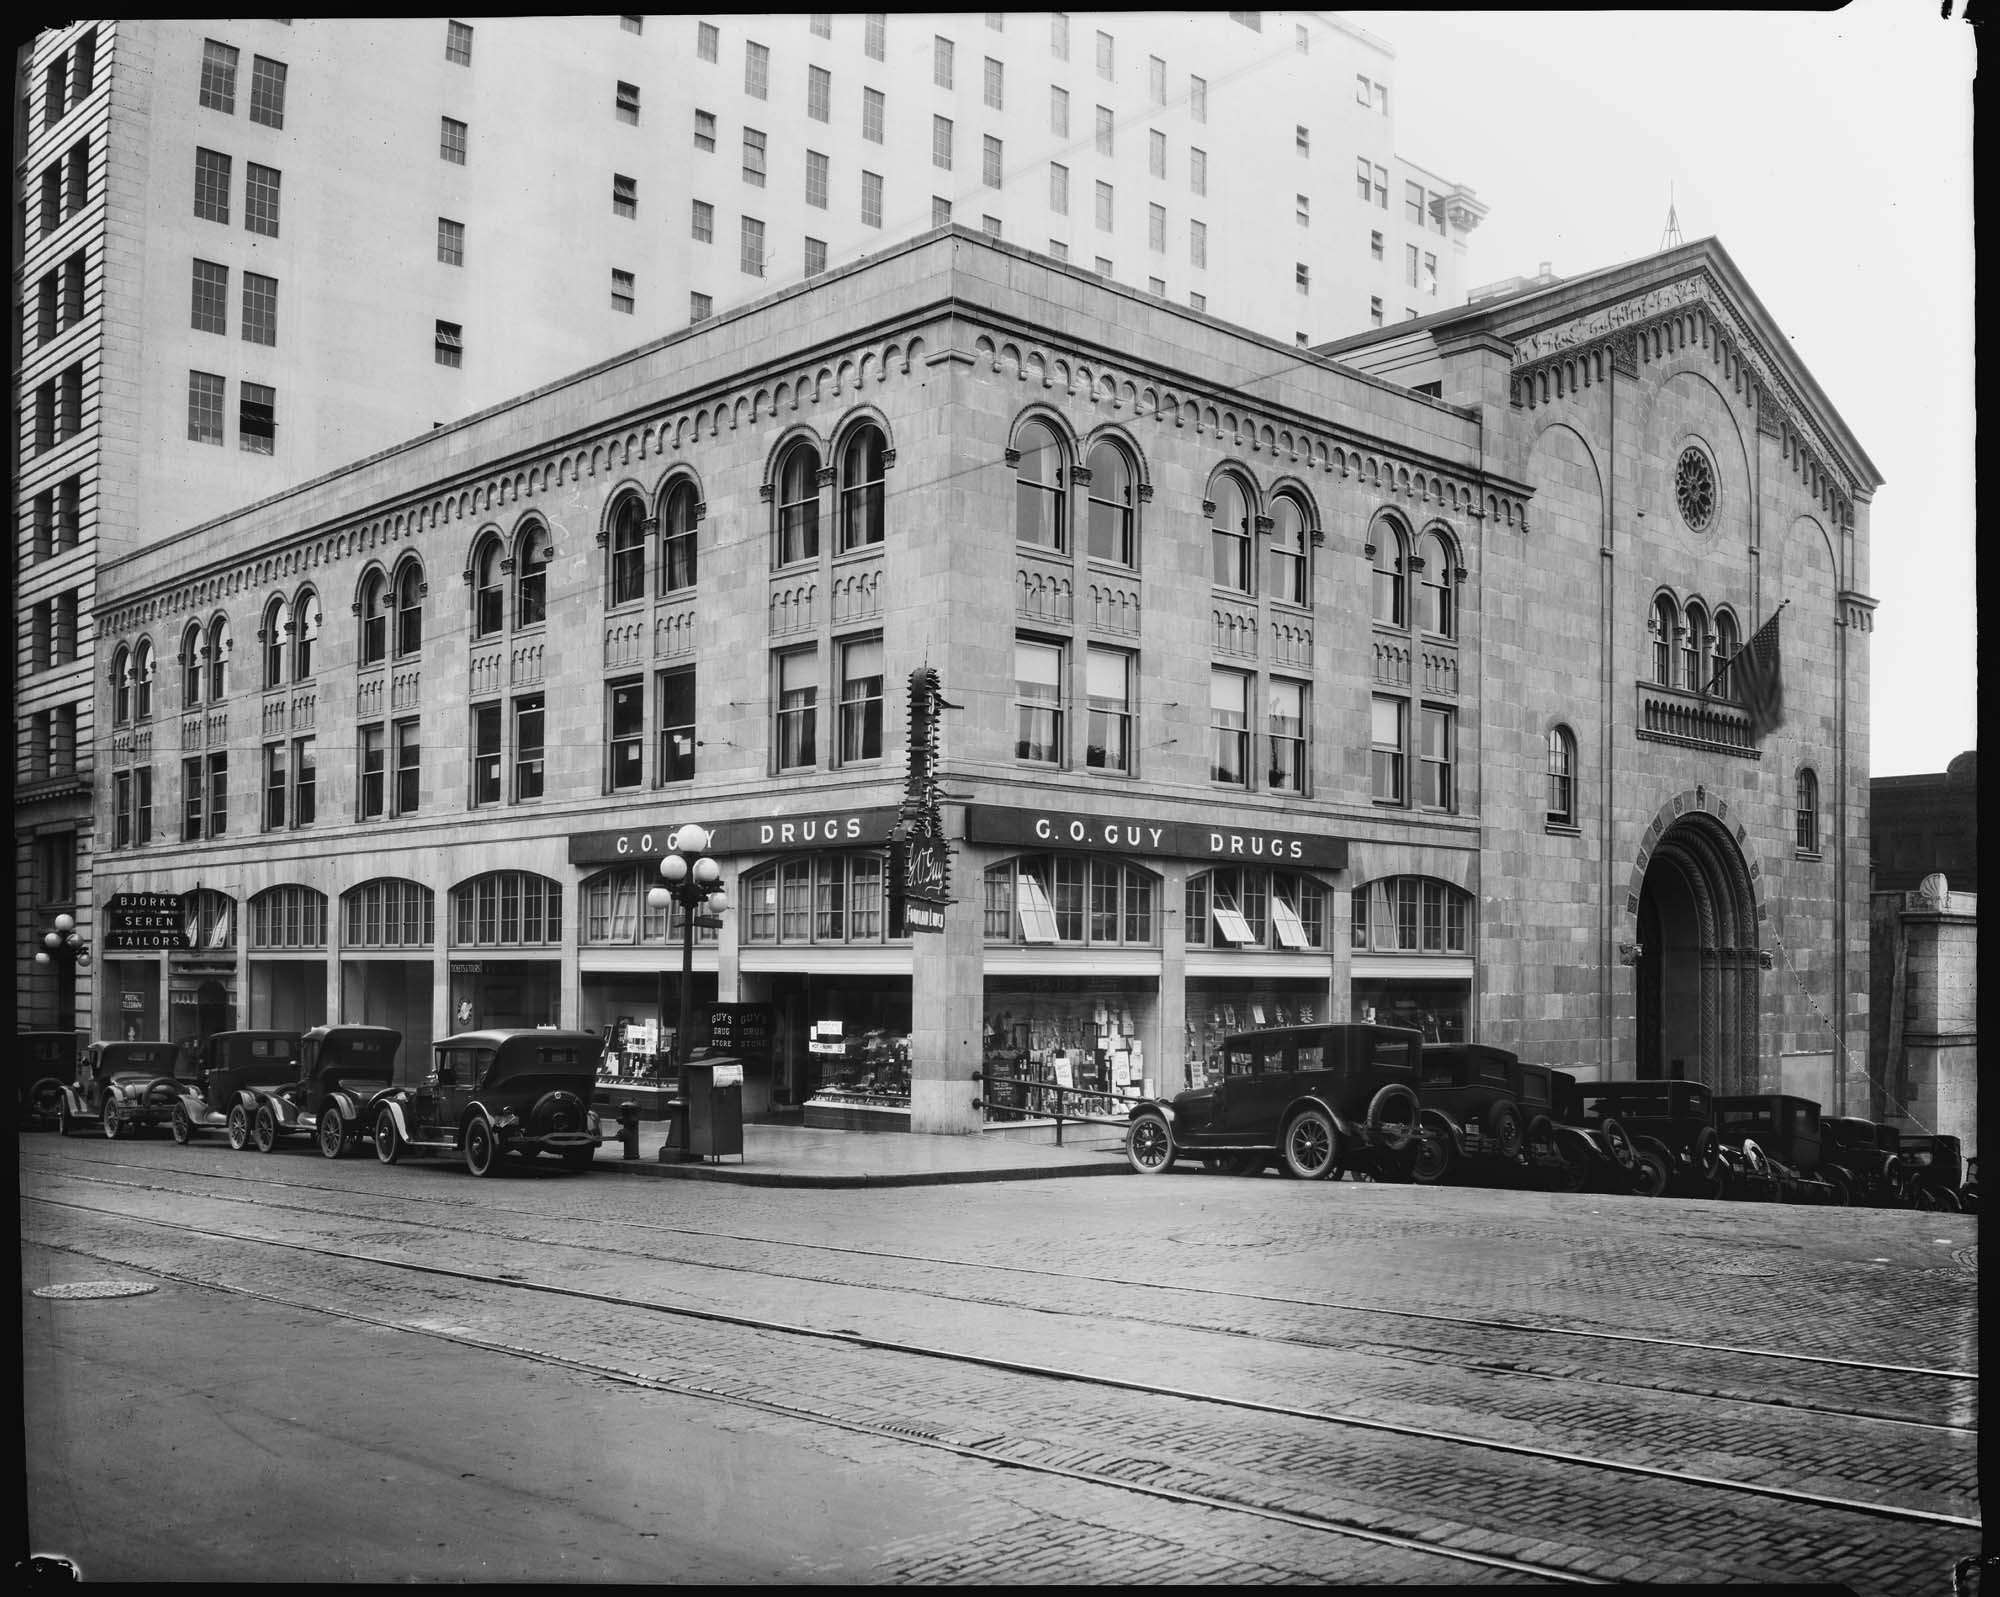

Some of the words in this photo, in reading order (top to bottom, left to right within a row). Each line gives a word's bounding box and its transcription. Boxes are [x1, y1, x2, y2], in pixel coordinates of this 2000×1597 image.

[761, 818, 861, 844] DRUGS
[1210, 833, 1302, 858] DRUGS
[125, 916, 174, 926] SEREN
[118, 936, 180, 946] TAILORS
[713, 1027, 731, 1036] DRUG
[711, 1039, 732, 1048] STORE
